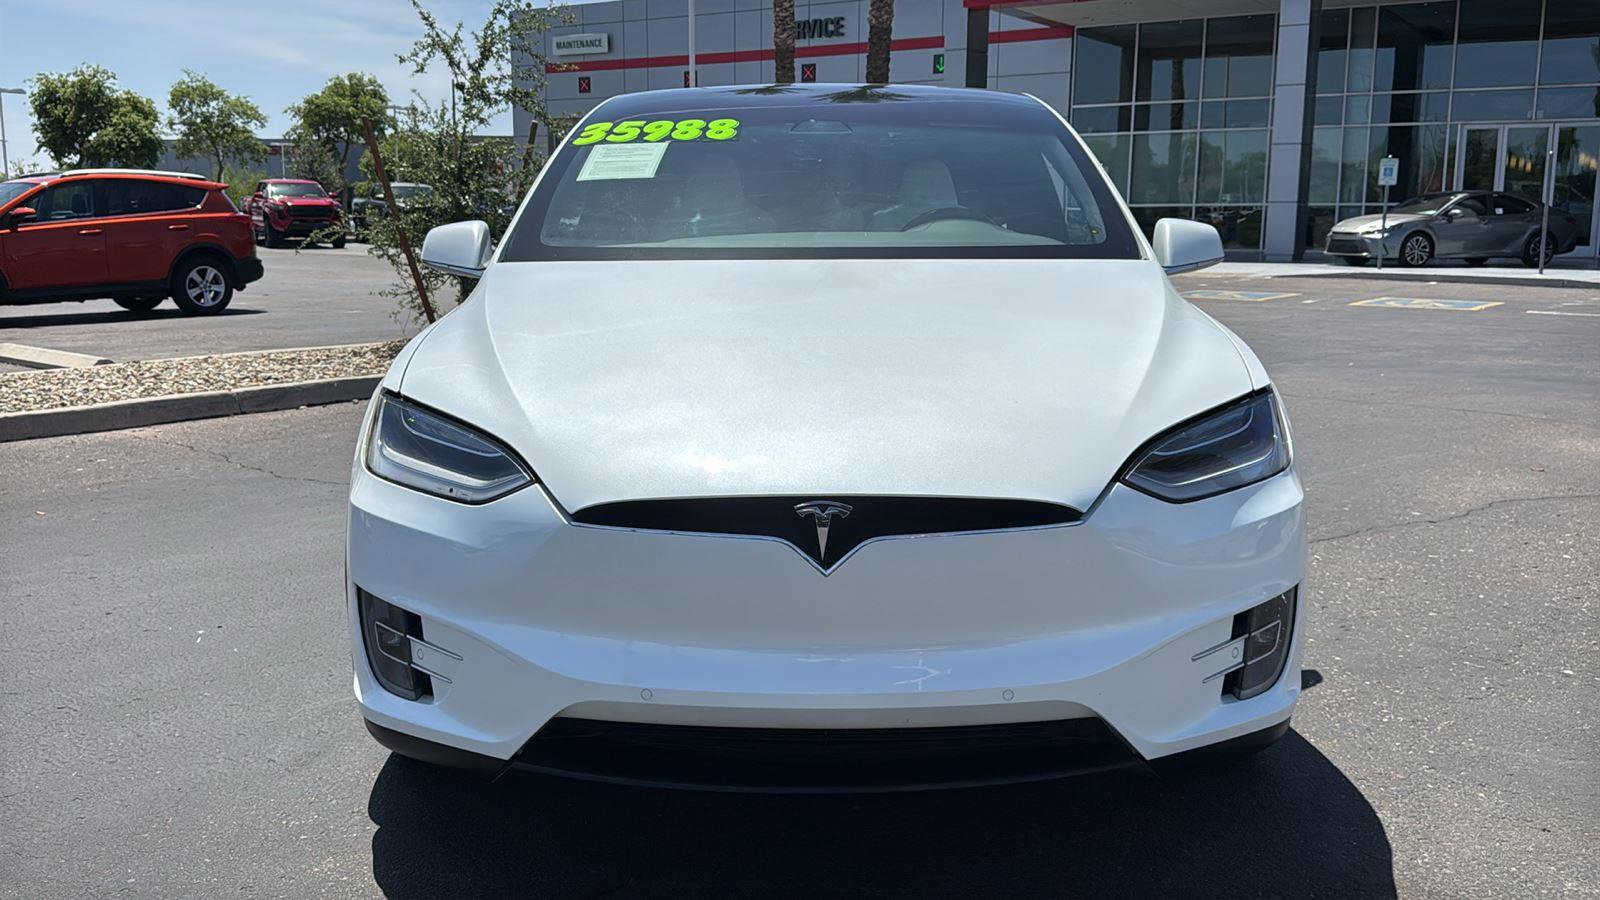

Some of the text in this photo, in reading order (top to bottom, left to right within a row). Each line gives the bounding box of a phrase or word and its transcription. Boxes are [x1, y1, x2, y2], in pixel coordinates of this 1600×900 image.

[794, 16, 846, 39] RVICE
[555, 38, 603, 50] MAINTENANCE
[571, 118, 740, 147] 35988
